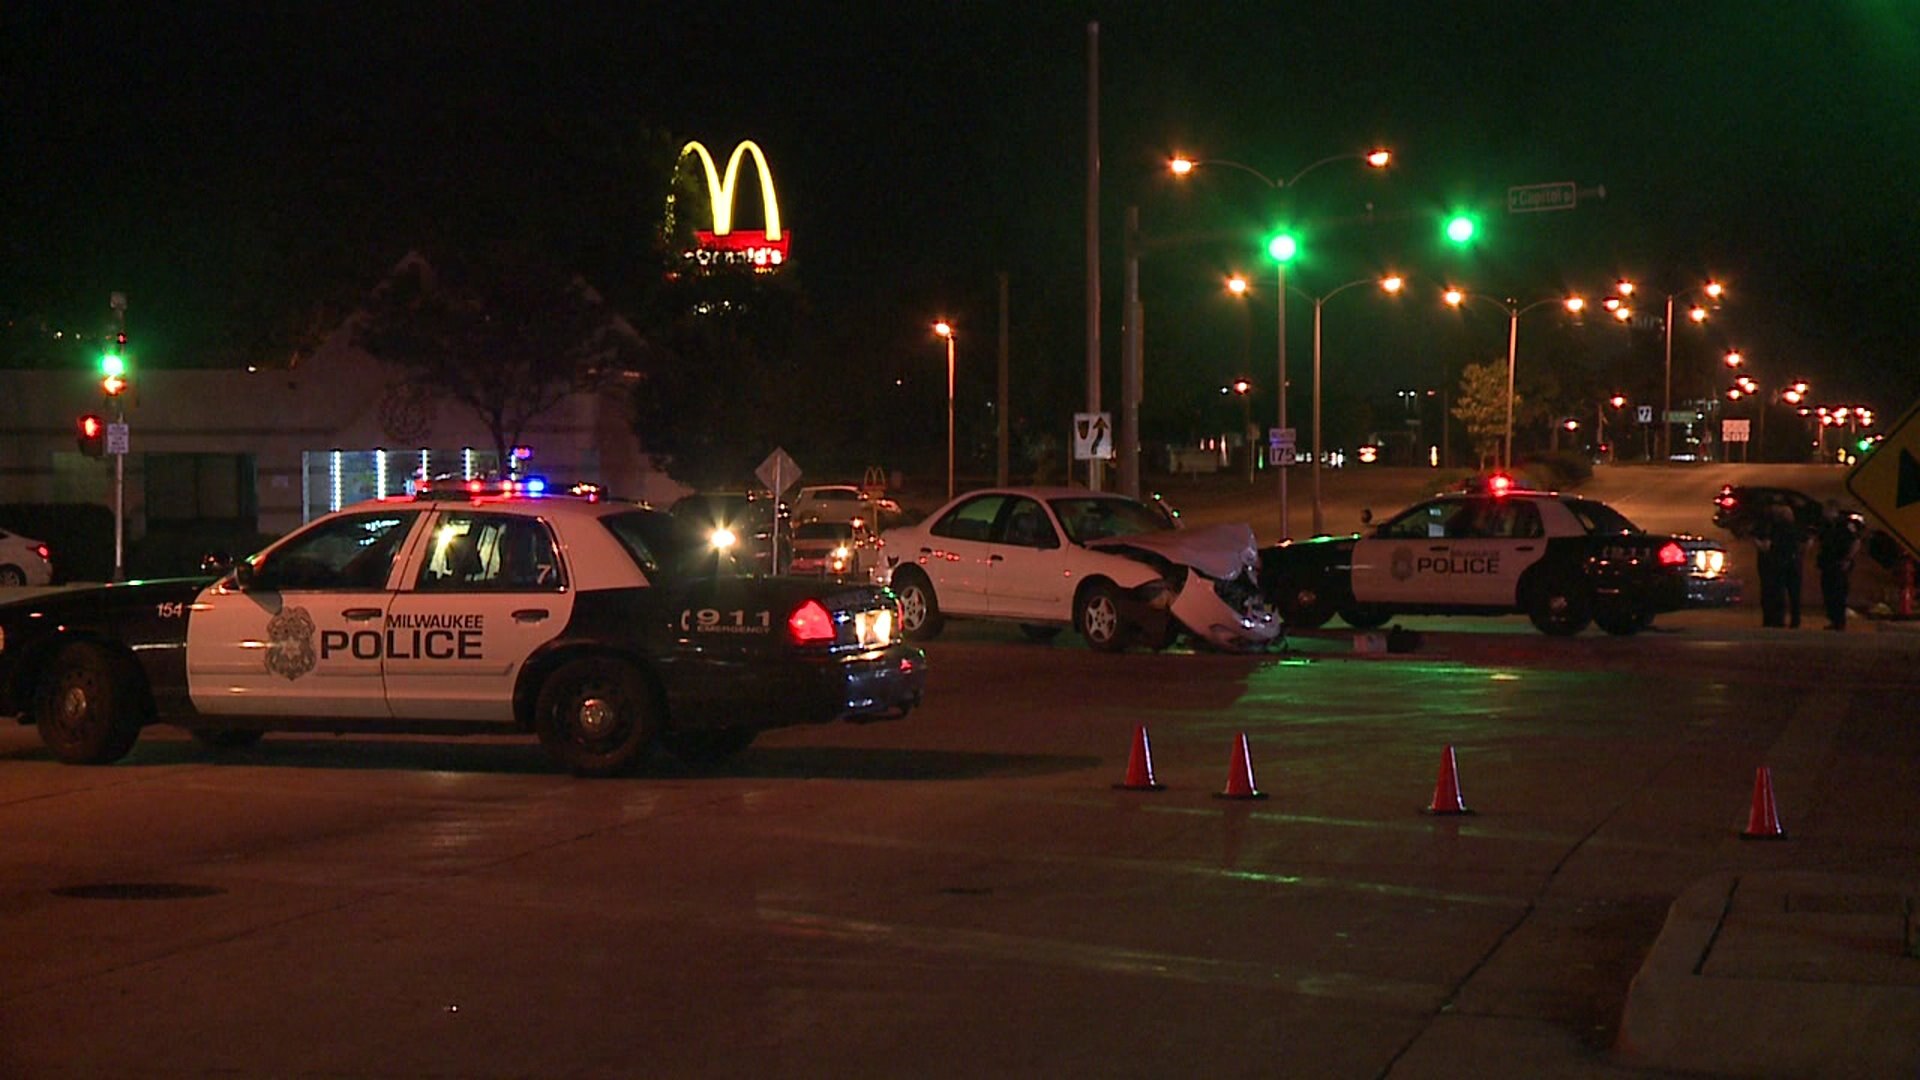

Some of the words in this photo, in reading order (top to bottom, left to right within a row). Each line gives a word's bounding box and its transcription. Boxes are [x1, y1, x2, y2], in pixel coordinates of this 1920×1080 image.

[1272, 448, 1295, 462] 175
[1417, 558, 1499, 574] POLICE
[536, 564, 552, 585] 7
[157, 602, 184, 618] 154
[697, 608, 771, 627] 911
[388, 615, 483, 629] MILWAUKEE
[321, 630, 483, 659] POLICE
